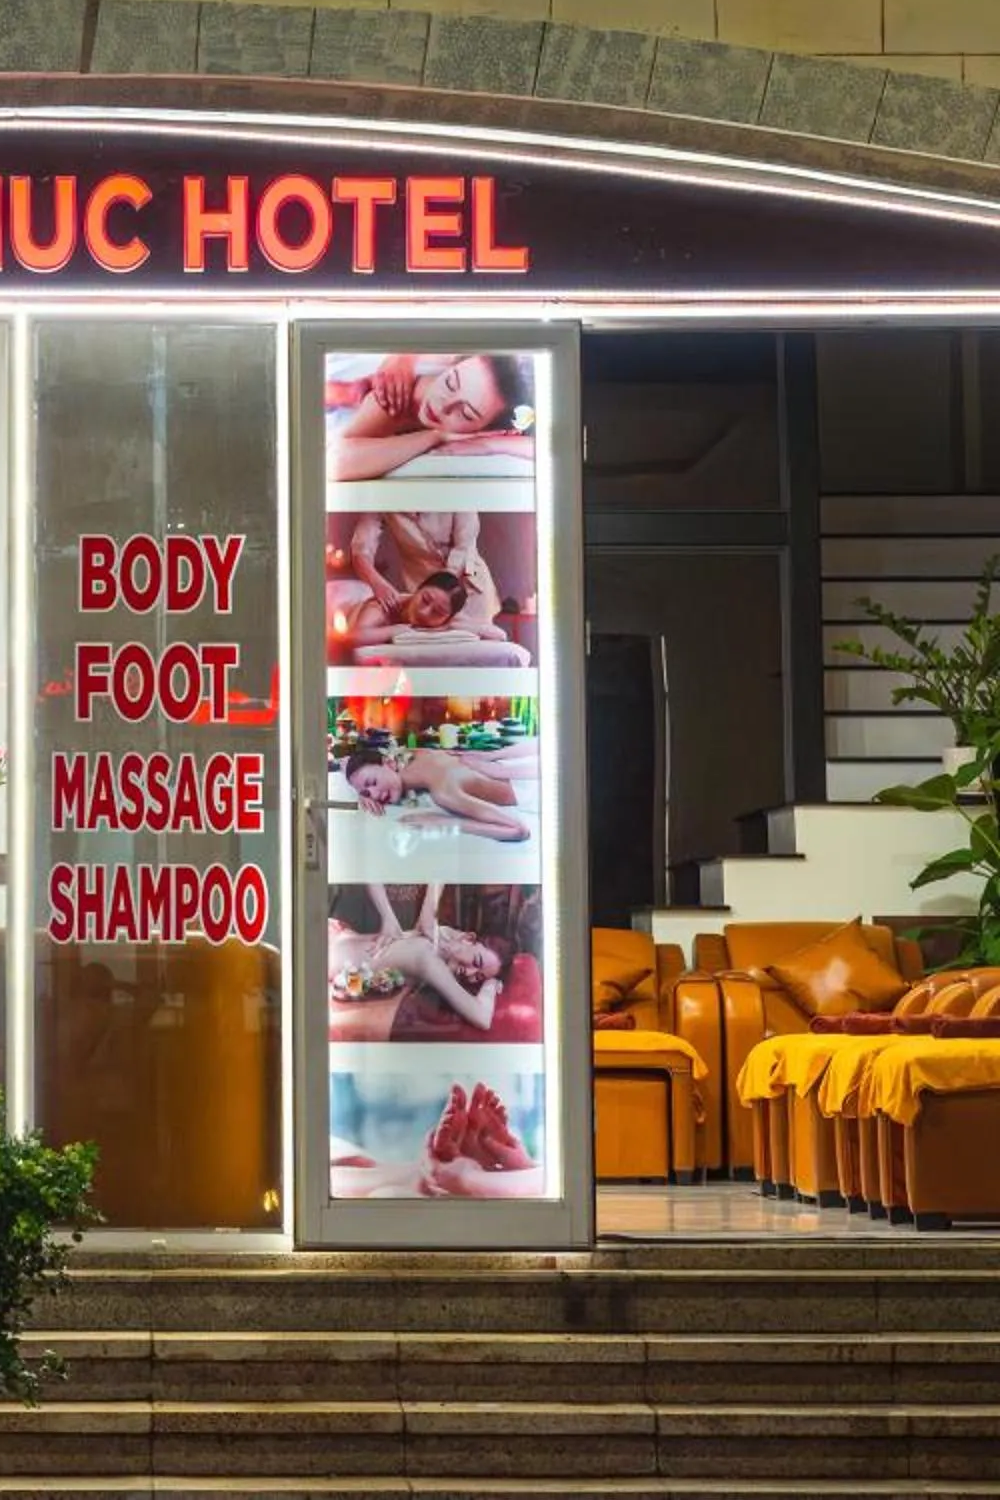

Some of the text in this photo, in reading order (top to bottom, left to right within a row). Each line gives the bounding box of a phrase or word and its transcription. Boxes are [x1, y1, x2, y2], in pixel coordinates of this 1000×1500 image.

[183, 173, 530, 274] HOTEL
[79, 534, 246, 613] BODY
[74, 642, 239, 723] FOOT
[52, 752, 265, 834] MASSAGE
[48, 862, 269, 945] SHAMPOO
